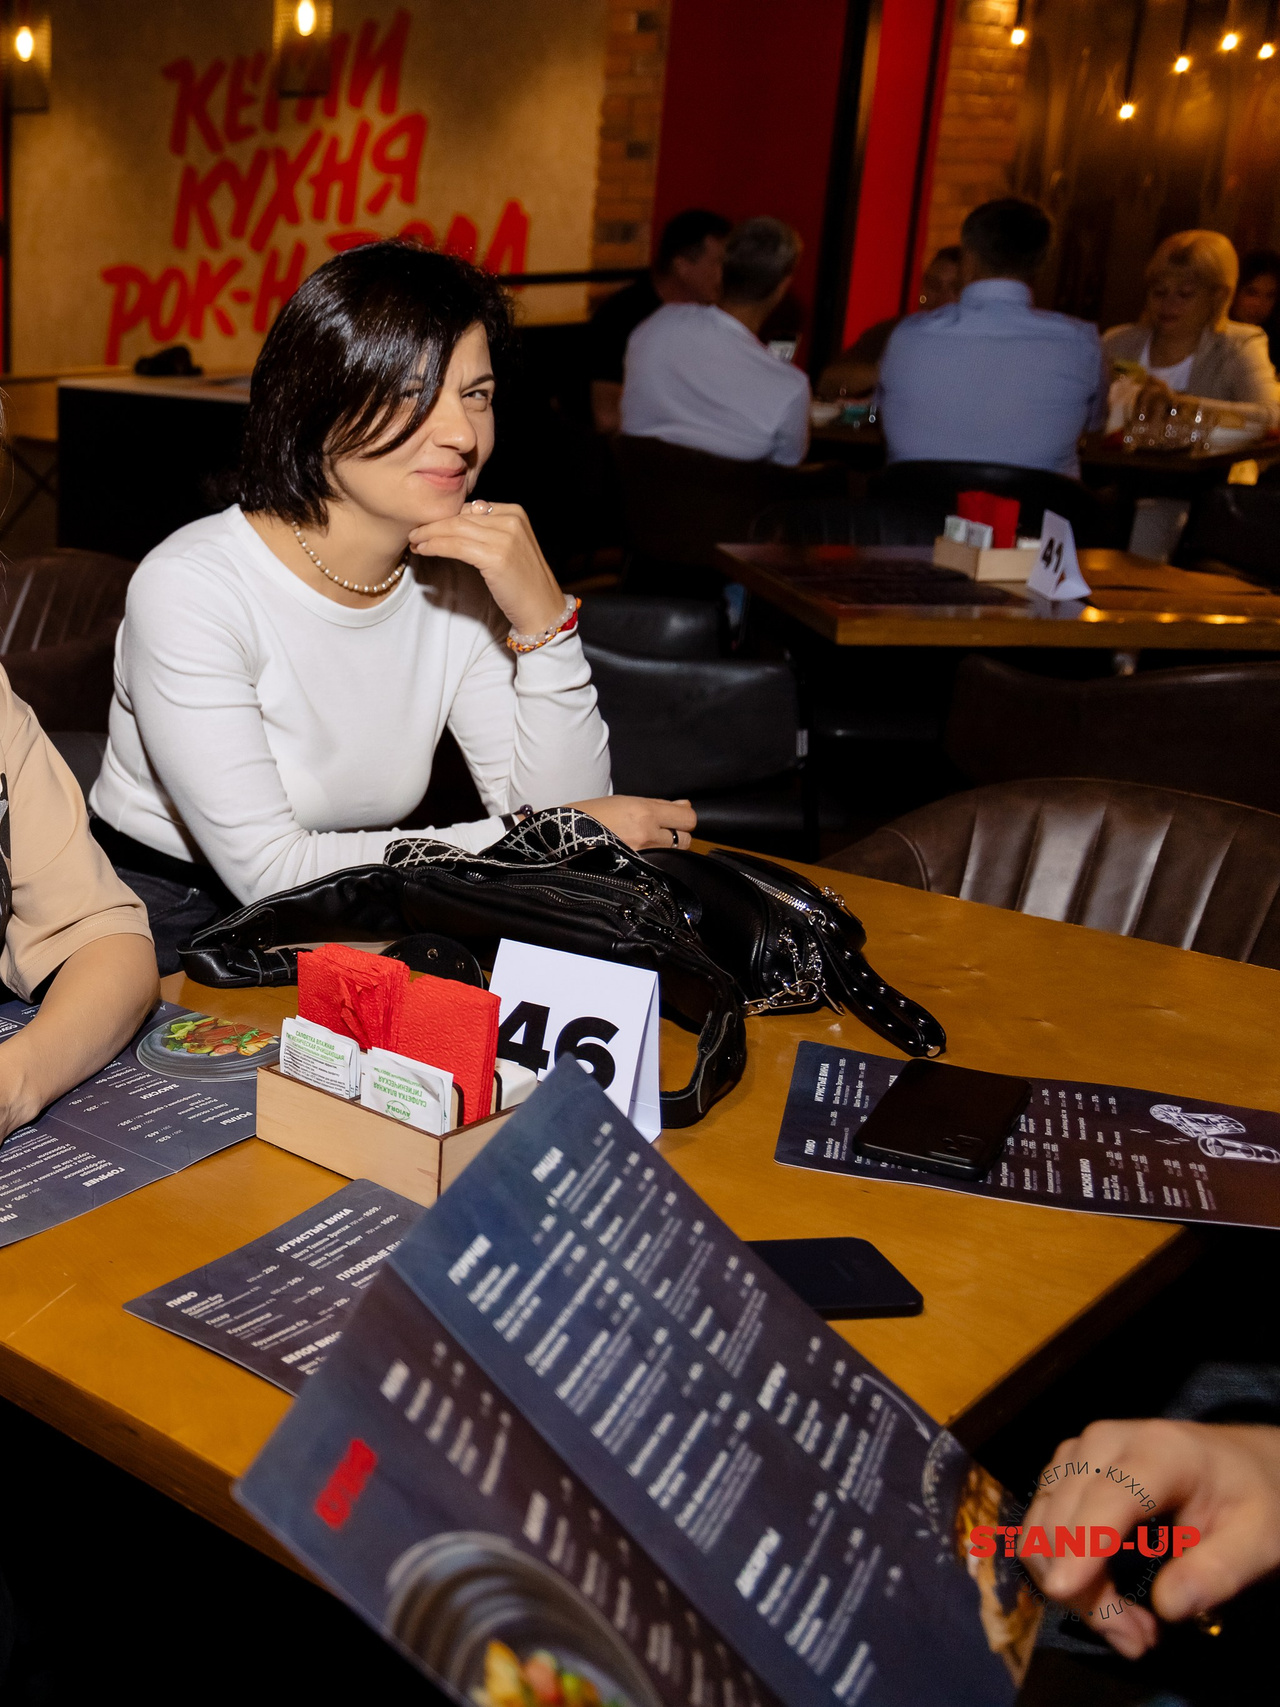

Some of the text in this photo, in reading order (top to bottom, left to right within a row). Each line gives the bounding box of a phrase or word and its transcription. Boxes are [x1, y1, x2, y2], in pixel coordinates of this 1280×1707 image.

[172, 110, 428, 251] КУХНЯ
[1042, 537, 1064, 573] 41
[295, 1030, 334, 1050] САЛФЕТКА ВЛАЖНАЯ
[497, 1000, 620, 1091] 46
[136, 1082, 181, 1100] ЗАКУСКИ
[378, 1075, 422, 1097] ГИГИЕНИЧЕСКАЯ
[813, 1061, 830, 1102] ИГРИСТЫЕ ВИНА
[372, 1082, 426, 1107] САЛФЕТКА ВЛАЖНАЯ
[217, 1110, 255, 1125] РОЛЛЫ
[386, 1103, 410, 1118] AVIORA
[28, 1137, 59, 1150] Шашлык
[803, 1138, 816, 1155] ПИВО
[75, 1153, 97, 1163] Паста
[35, 1163, 75, 1180] креветками
[80, 1166, 127, 1187] ГОРЯЧЕЕ
[1078, 1157, 1095, 1198] КРАСНОЕ ВИНО
[274, 1206, 355, 1253] ИГРИСТЫЕ ВИНА
[289, 1247, 310, 1259] Шато
[305, 1235, 330, 1250] Тамань
[325, 1223, 351, 1238] Эритаж
[307, 1255, 328, 1267] Шато
[323, 1242, 349, 1258] Тамань
[344, 1234, 365, 1246] Брют
[333, 1248, 392, 1281] ПЛОДОВЫЕ
[164, 1289, 201, 1308] ПИВО
[278, 1343, 321, 1365] БЕЛОЕ
